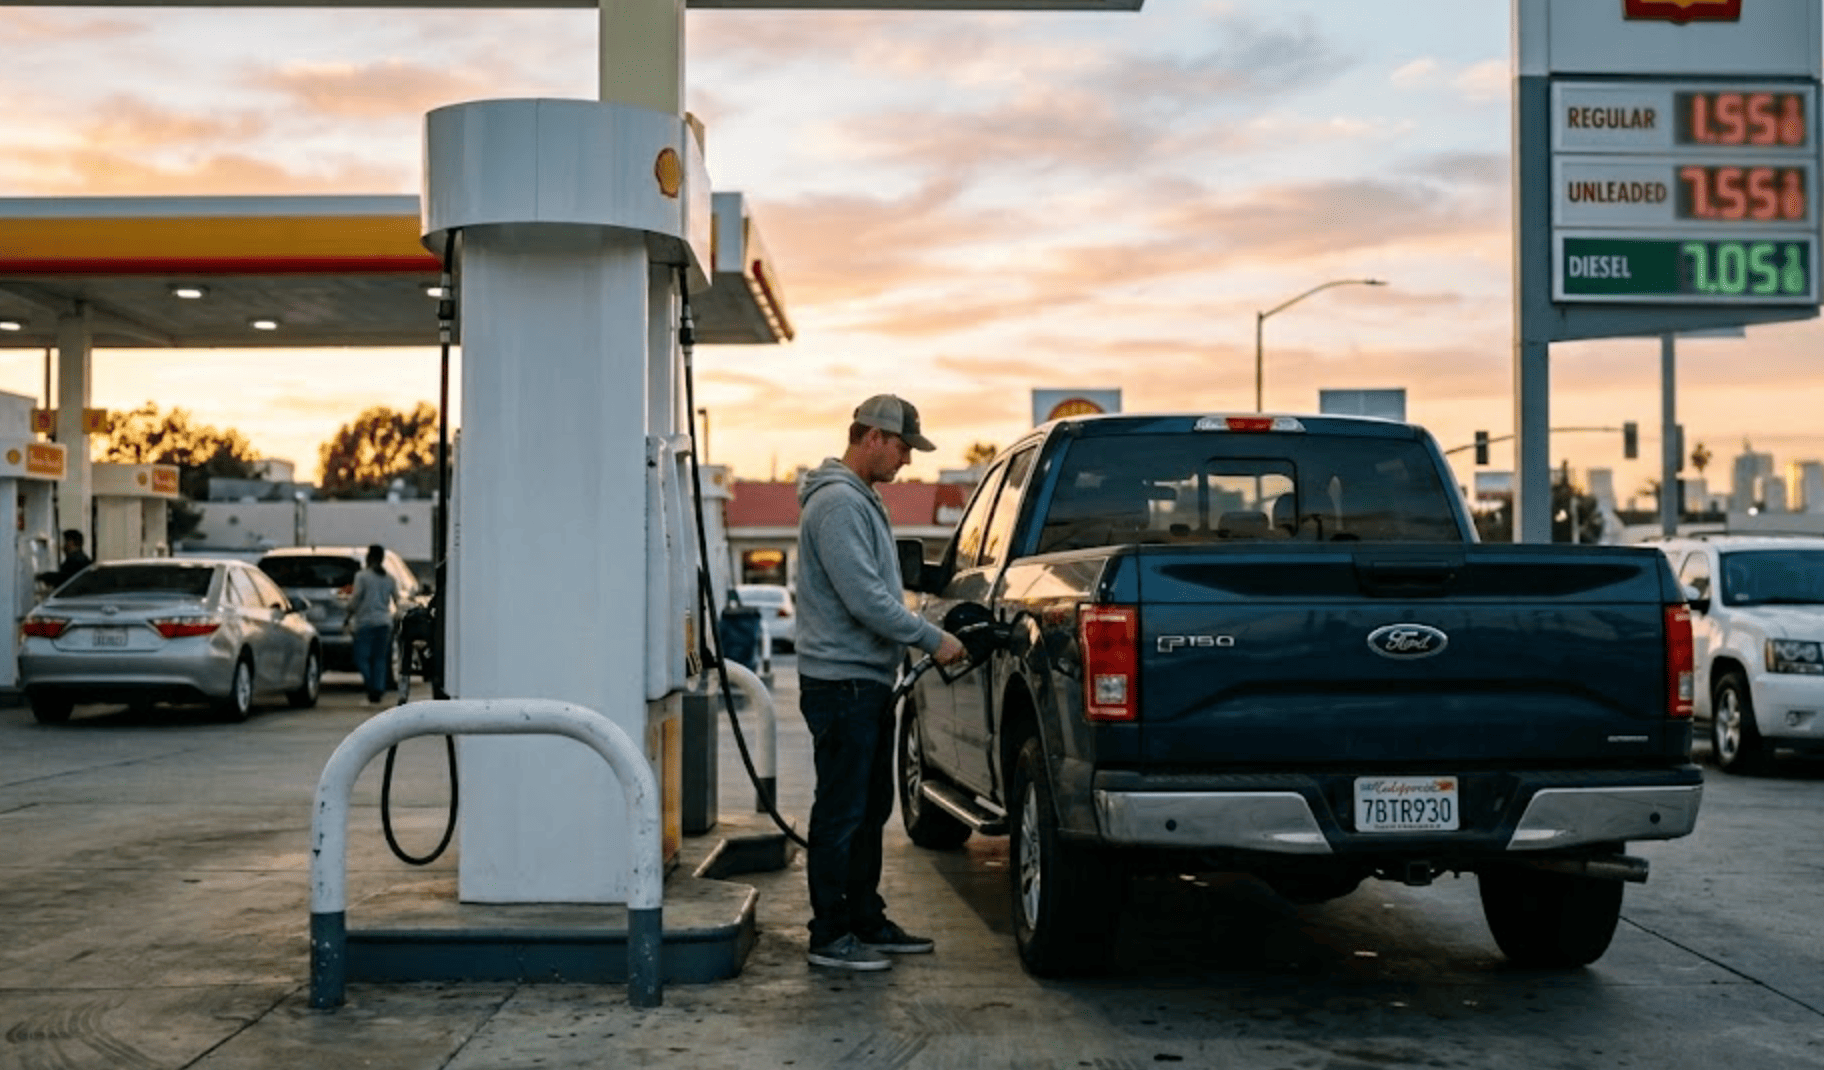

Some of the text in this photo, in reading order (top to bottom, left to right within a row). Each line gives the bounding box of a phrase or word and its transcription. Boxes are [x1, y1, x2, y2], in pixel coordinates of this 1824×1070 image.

[1567, 106, 1656, 129] REGULAR
[1568, 181, 1667, 204] UNLEADED
[1568, 254, 1632, 278] DIESEL
[1385, 629, 1433, 651] Ford
[1362, 797, 1451, 824] 7BTR930
